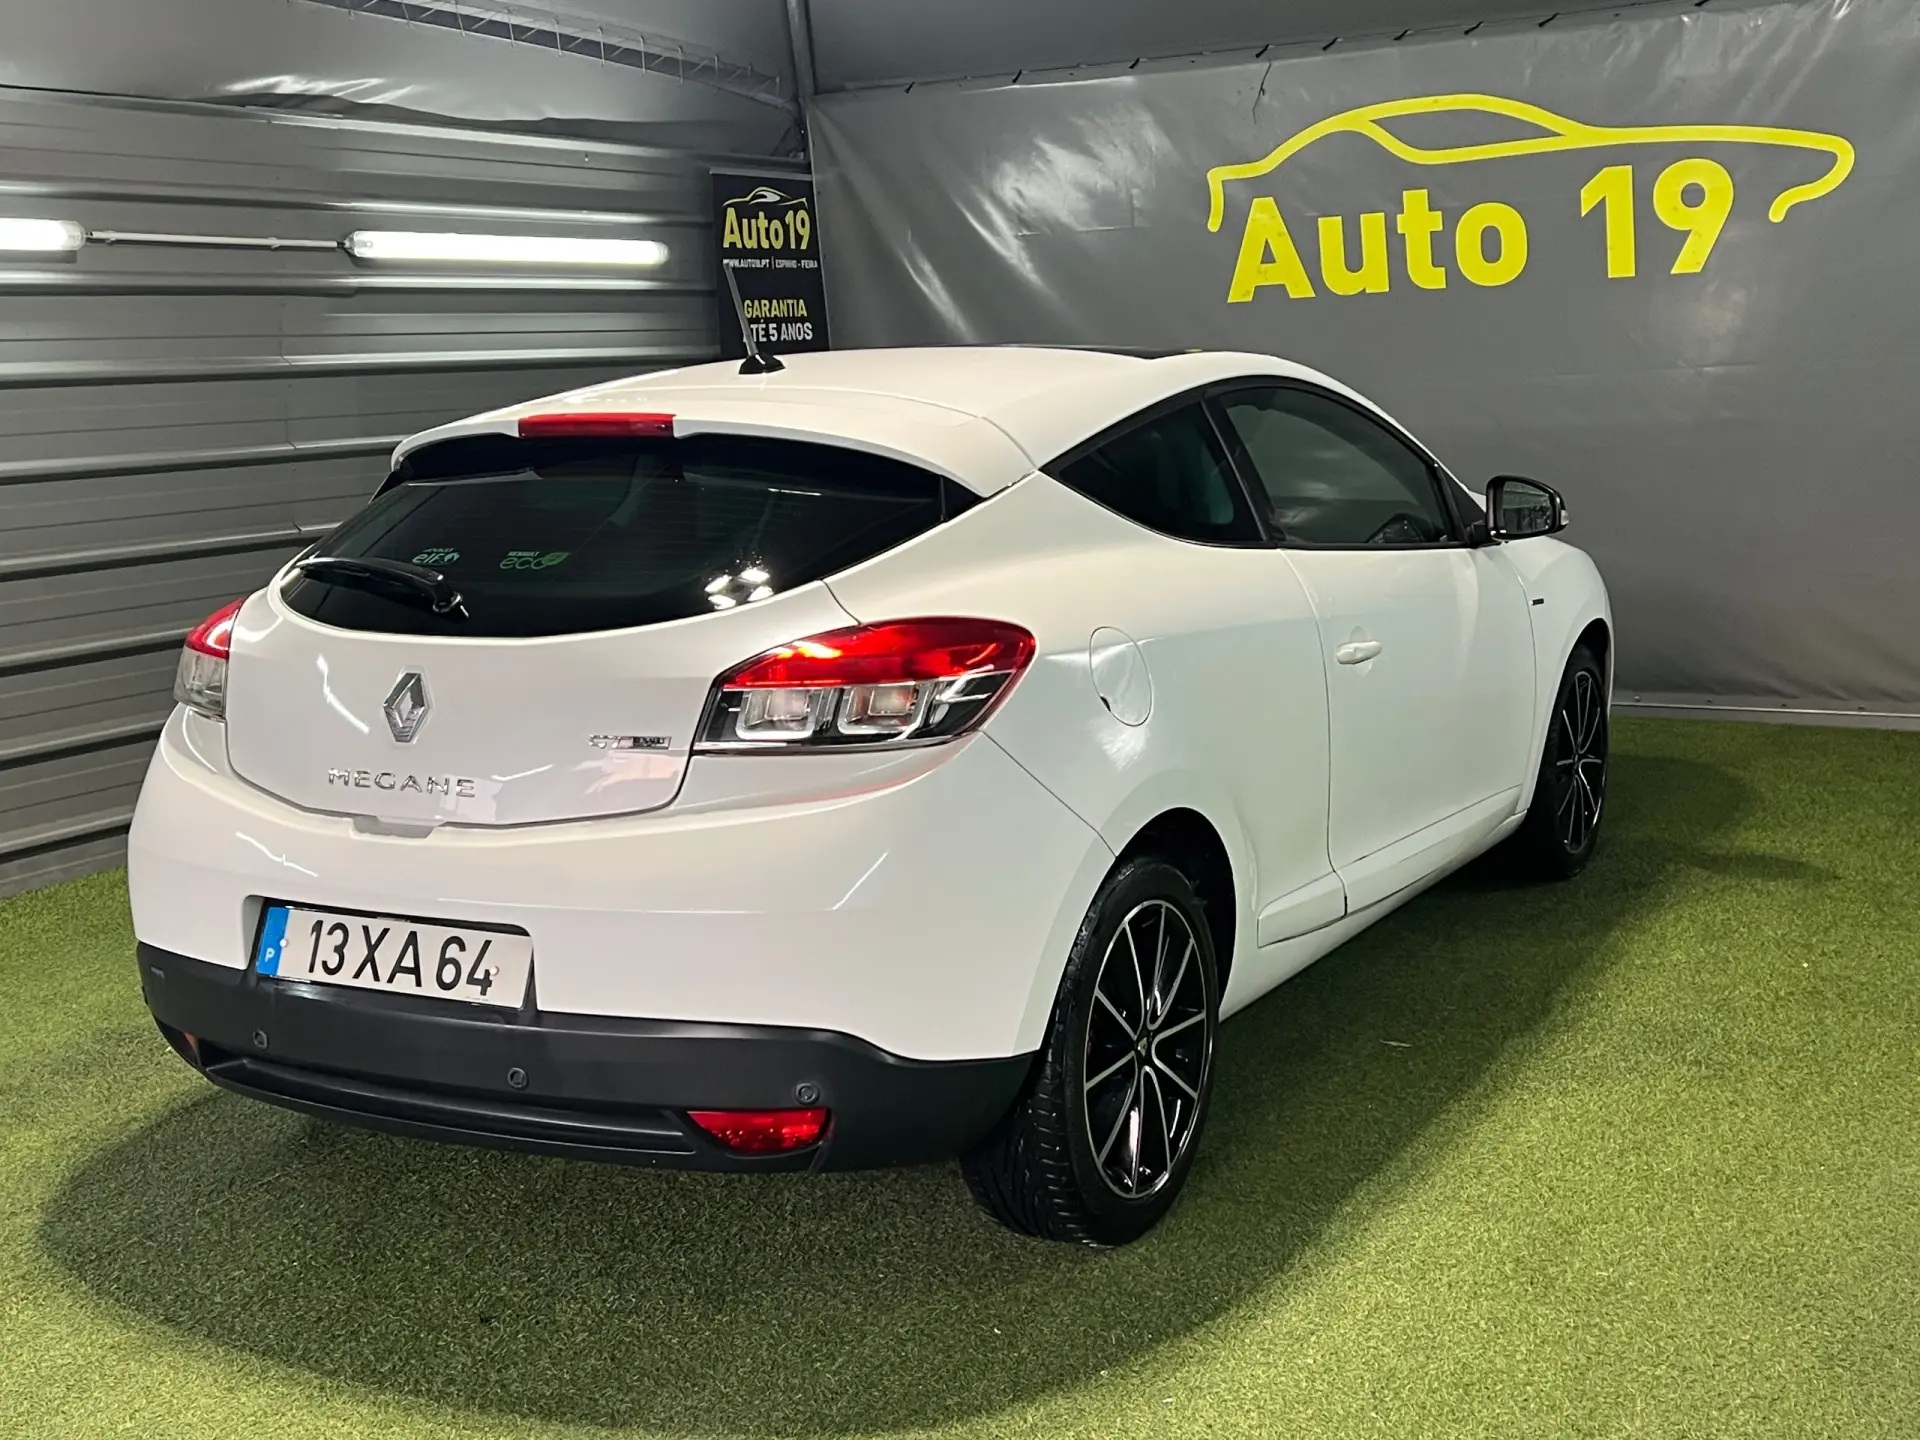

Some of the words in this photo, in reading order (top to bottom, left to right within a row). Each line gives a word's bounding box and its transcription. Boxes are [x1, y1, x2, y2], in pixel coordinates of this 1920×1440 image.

[1227, 188, 1528, 303] Auto
[1580, 158, 1734, 278] 19
[743, 299, 808, 319] GARANTIA
[768, 323, 778, 342] 5
[780, 322, 813, 341] ANOS
[328, 767, 476, 798] MEGANE
[265, 947, 275, 963] P
